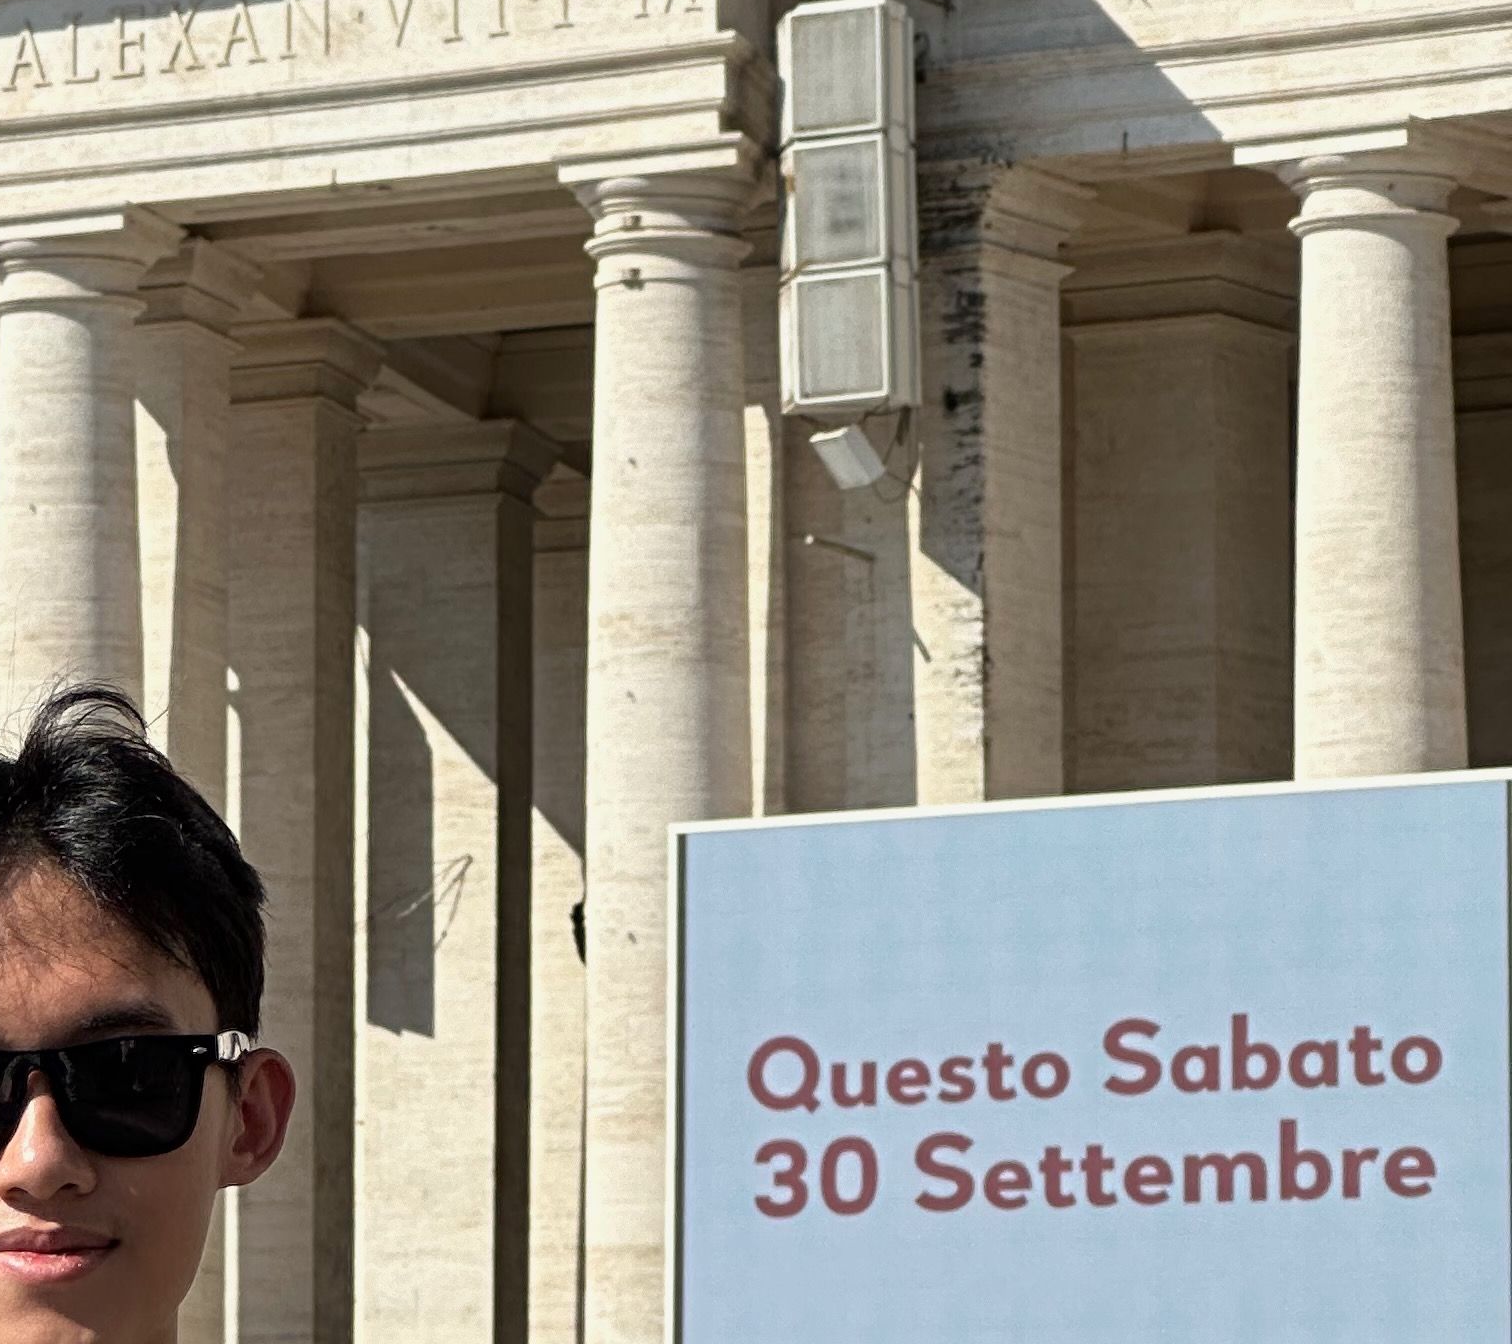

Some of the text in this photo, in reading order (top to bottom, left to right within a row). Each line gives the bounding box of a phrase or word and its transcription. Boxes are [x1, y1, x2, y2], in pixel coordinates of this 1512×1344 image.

[746, 1012, 1443, 1115] Questo Sabato
[753, 1118, 1437, 1219] 30 Settembre
